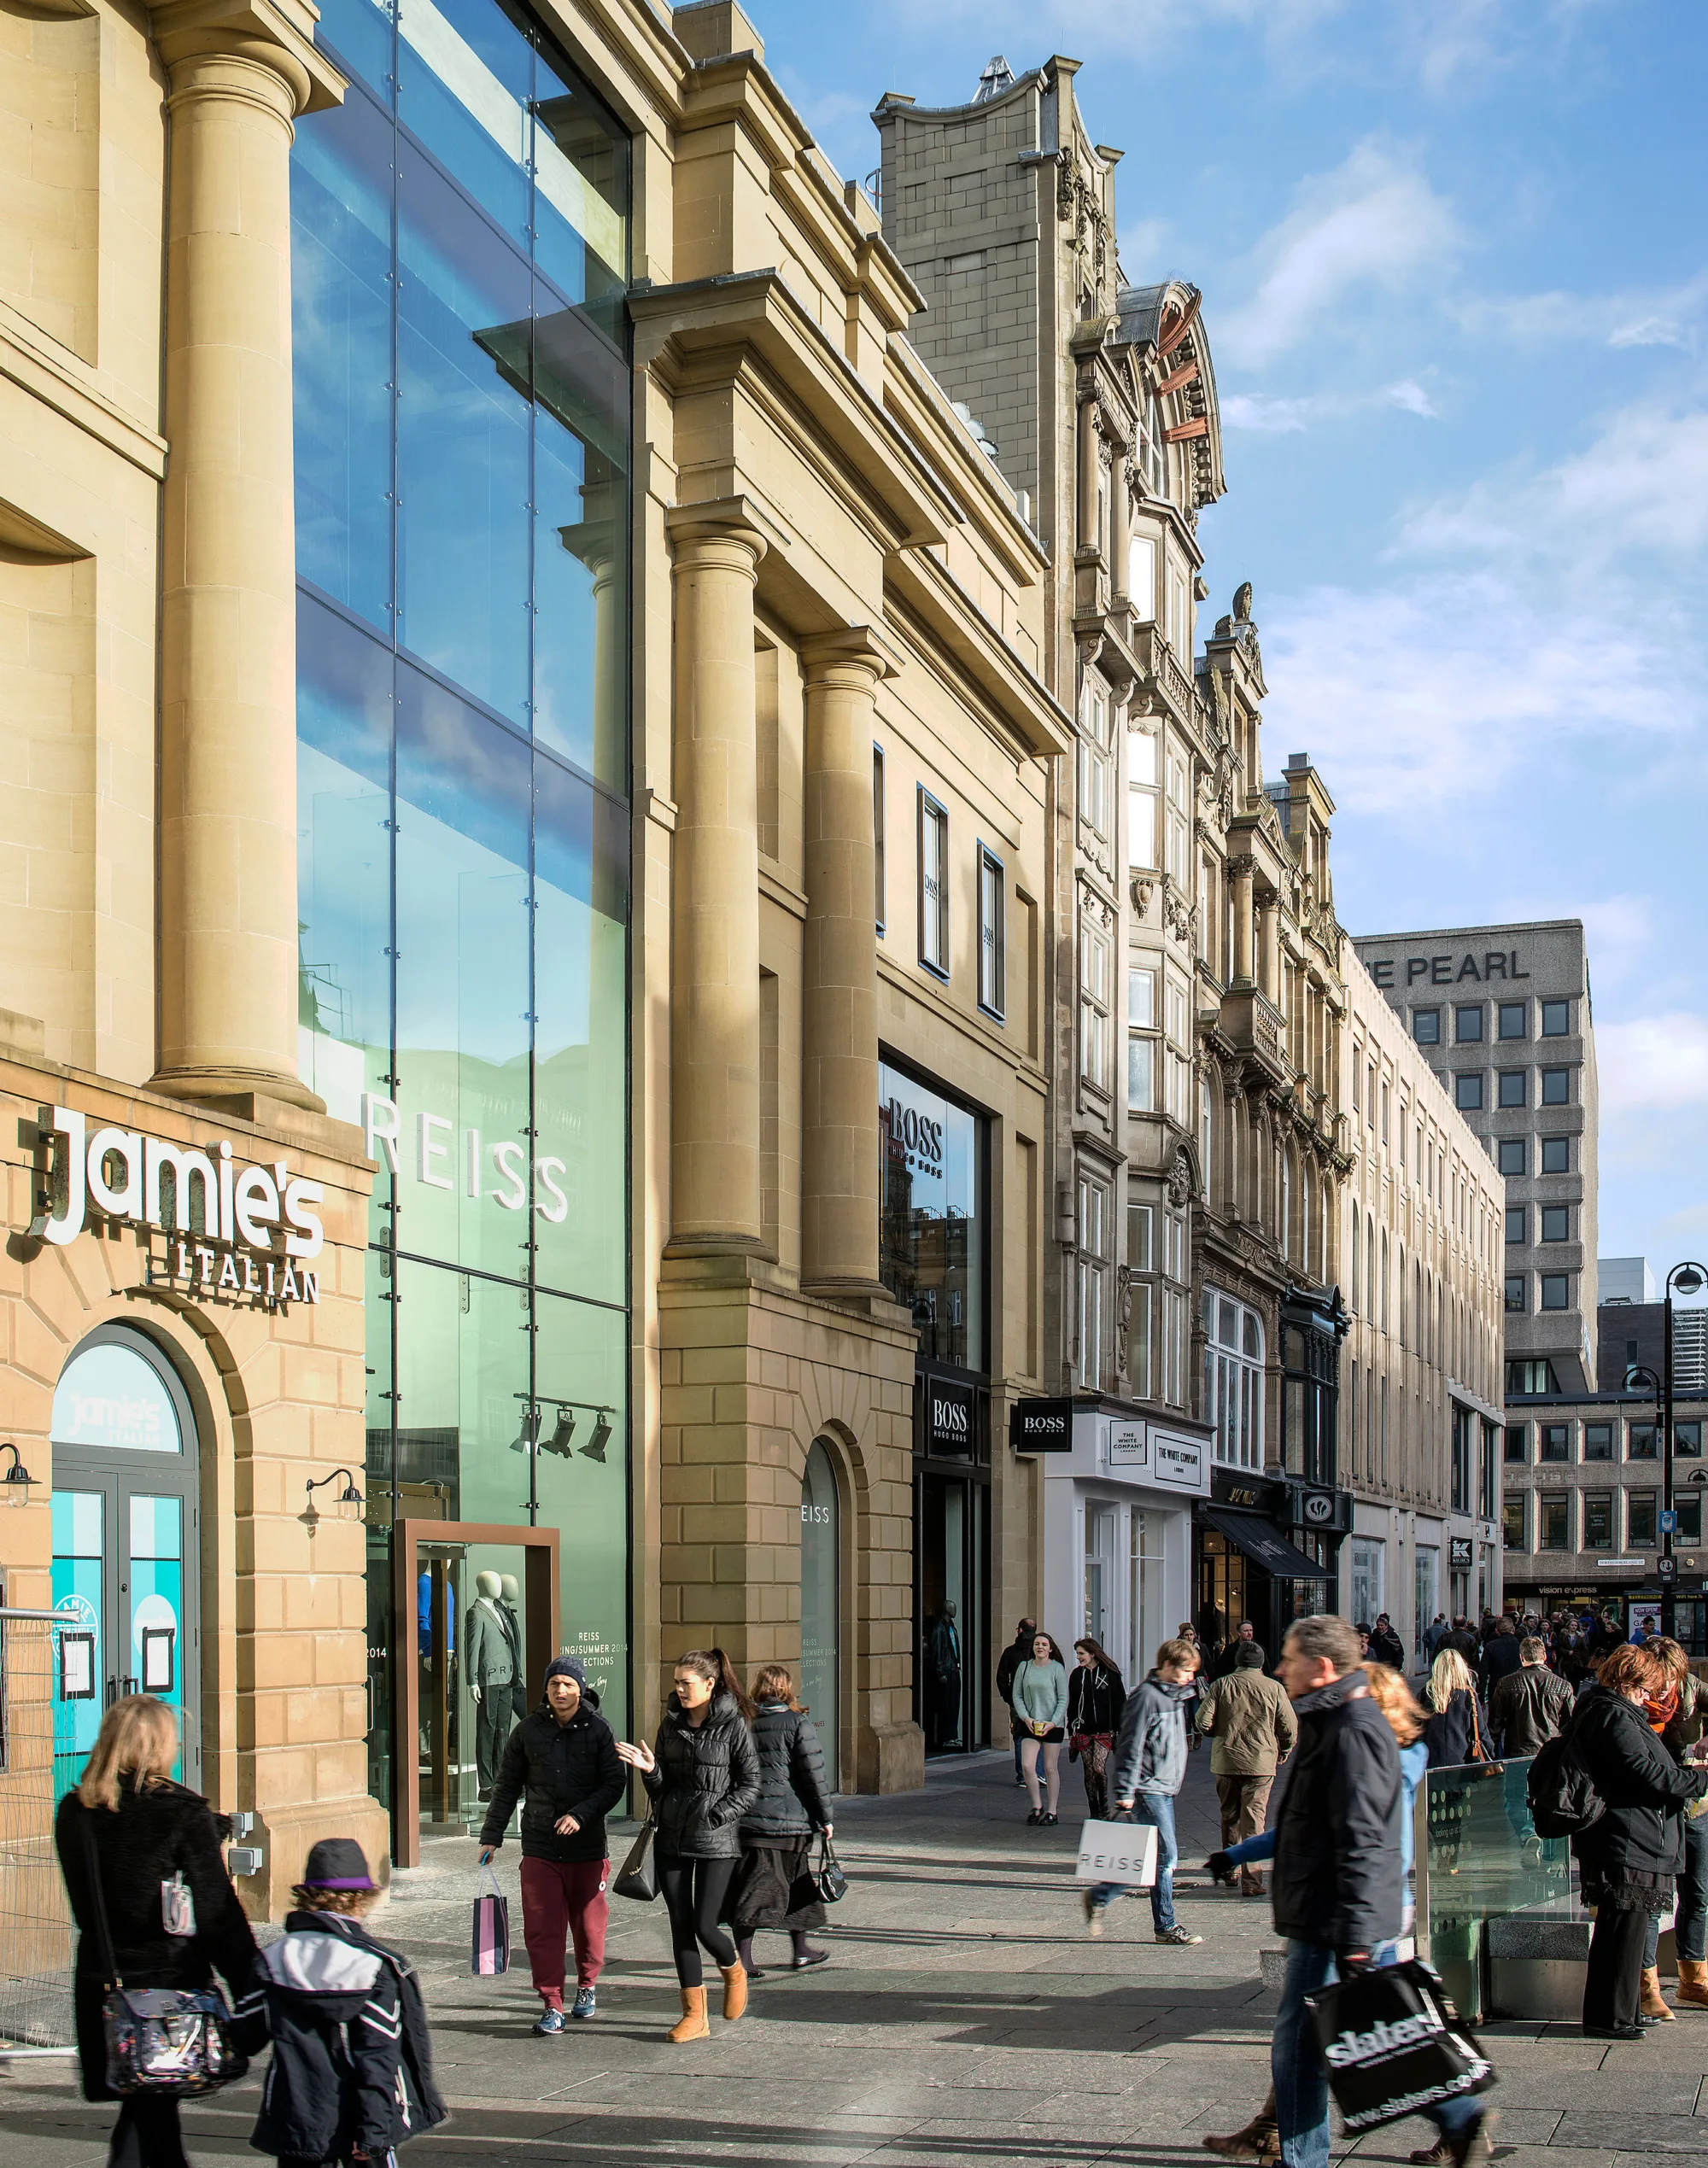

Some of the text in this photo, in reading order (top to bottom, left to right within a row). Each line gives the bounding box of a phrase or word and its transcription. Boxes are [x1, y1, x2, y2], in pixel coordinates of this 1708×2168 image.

[925, 874, 938, 897] OSS
[1407, 950, 1530, 985] PEARL
[888, 1097, 943, 1163] BOSS
[360, 1091, 569, 1223] REISS
[890, 1144, 943, 1179] HUGO BOSS
[177, 1242, 321, 1305] ITALIAN
[933, 1399, 967, 1432] BOSS
[1025, 1417, 1065, 1429] BOSS
[933, 1429, 967, 1443] HUGO BOSS
[1158, 1446, 1198, 1465] THE WHITE COMPANY
[800, 1505, 829, 1524] EISS
[1539, 1586, 1563, 1594] vision
[578, 1632, 600, 1641] REISS
[803, 1638, 817, 1646] REISS
[560, 1644, 610, 1655] ING/SUMMER
[582, 1657, 614, 1667] ECTIONS
[1078, 1853, 1144, 1872] REISS
